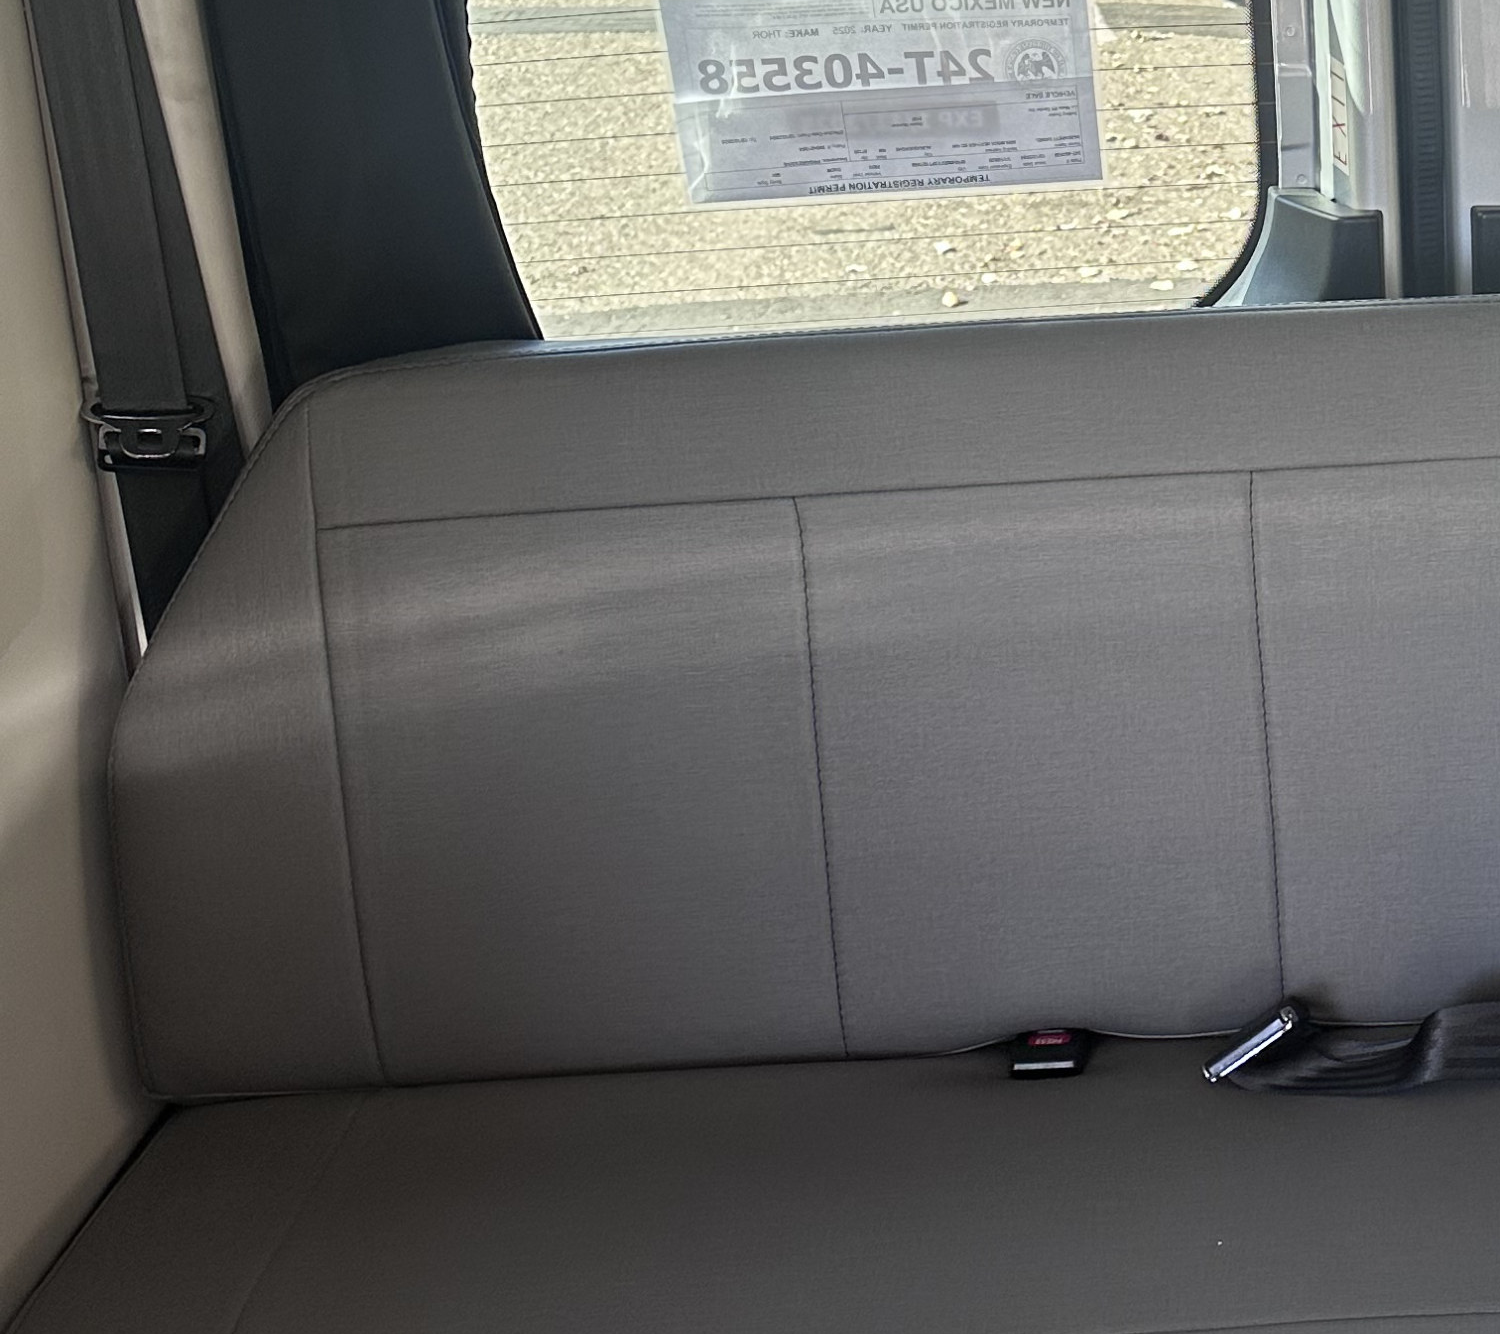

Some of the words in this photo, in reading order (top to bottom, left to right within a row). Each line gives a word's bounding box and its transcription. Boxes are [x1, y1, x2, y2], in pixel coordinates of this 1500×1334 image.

[848, 178, 925, 191] REGISTRATION
[927, 174, 990, 185] TEMPORARY
[808, 183, 846, 195] PERMIT
